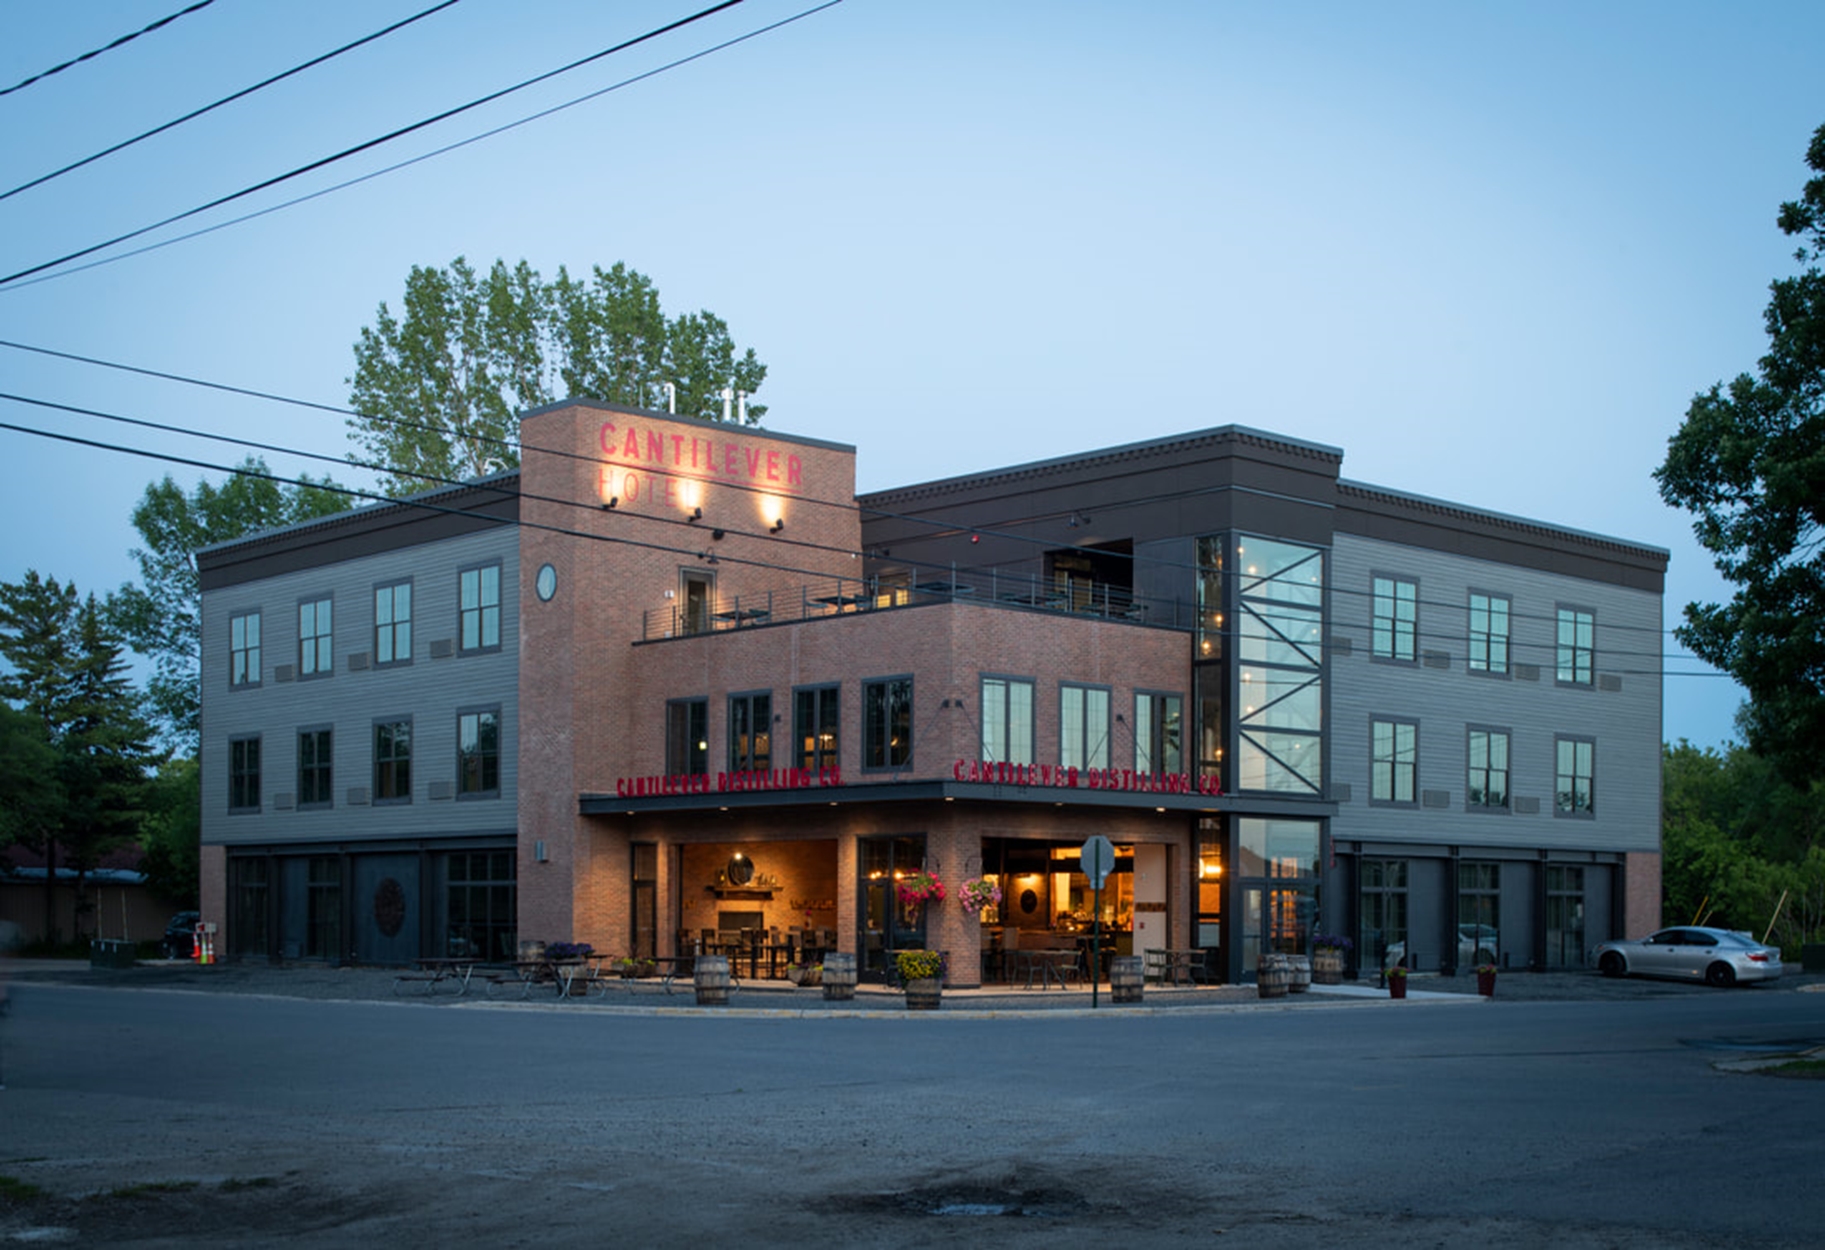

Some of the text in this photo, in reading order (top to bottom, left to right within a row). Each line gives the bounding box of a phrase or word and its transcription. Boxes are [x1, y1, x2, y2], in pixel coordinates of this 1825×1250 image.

[600, 422, 802, 485] CANTILEVER
[616, 764, 846, 798] CANTILEVER DISTILLING CO.
[954, 759, 1225, 796] CANTILEVER DISTILLING CO.
